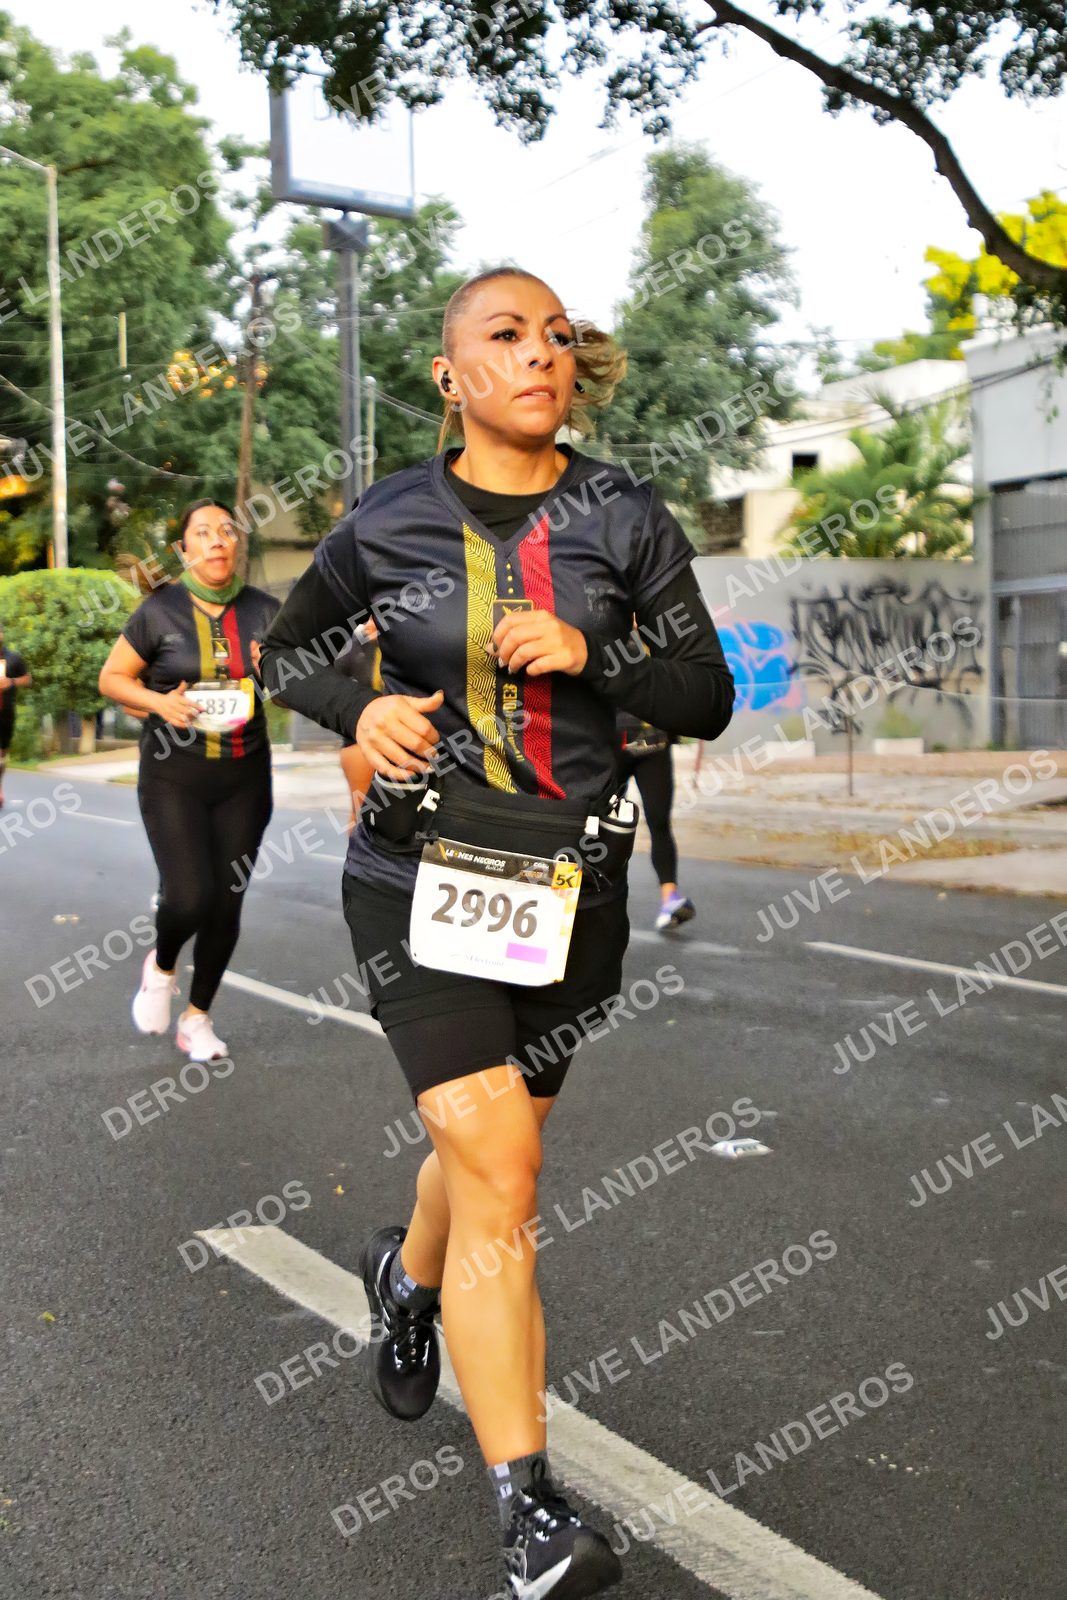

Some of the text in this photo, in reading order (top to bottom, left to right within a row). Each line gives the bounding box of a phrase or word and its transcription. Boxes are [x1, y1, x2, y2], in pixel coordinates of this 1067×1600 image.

[473, 855, 506, 868] NEGROS
[555, 873, 576, 888] 5K
[431, 882, 538, 939] 2996
